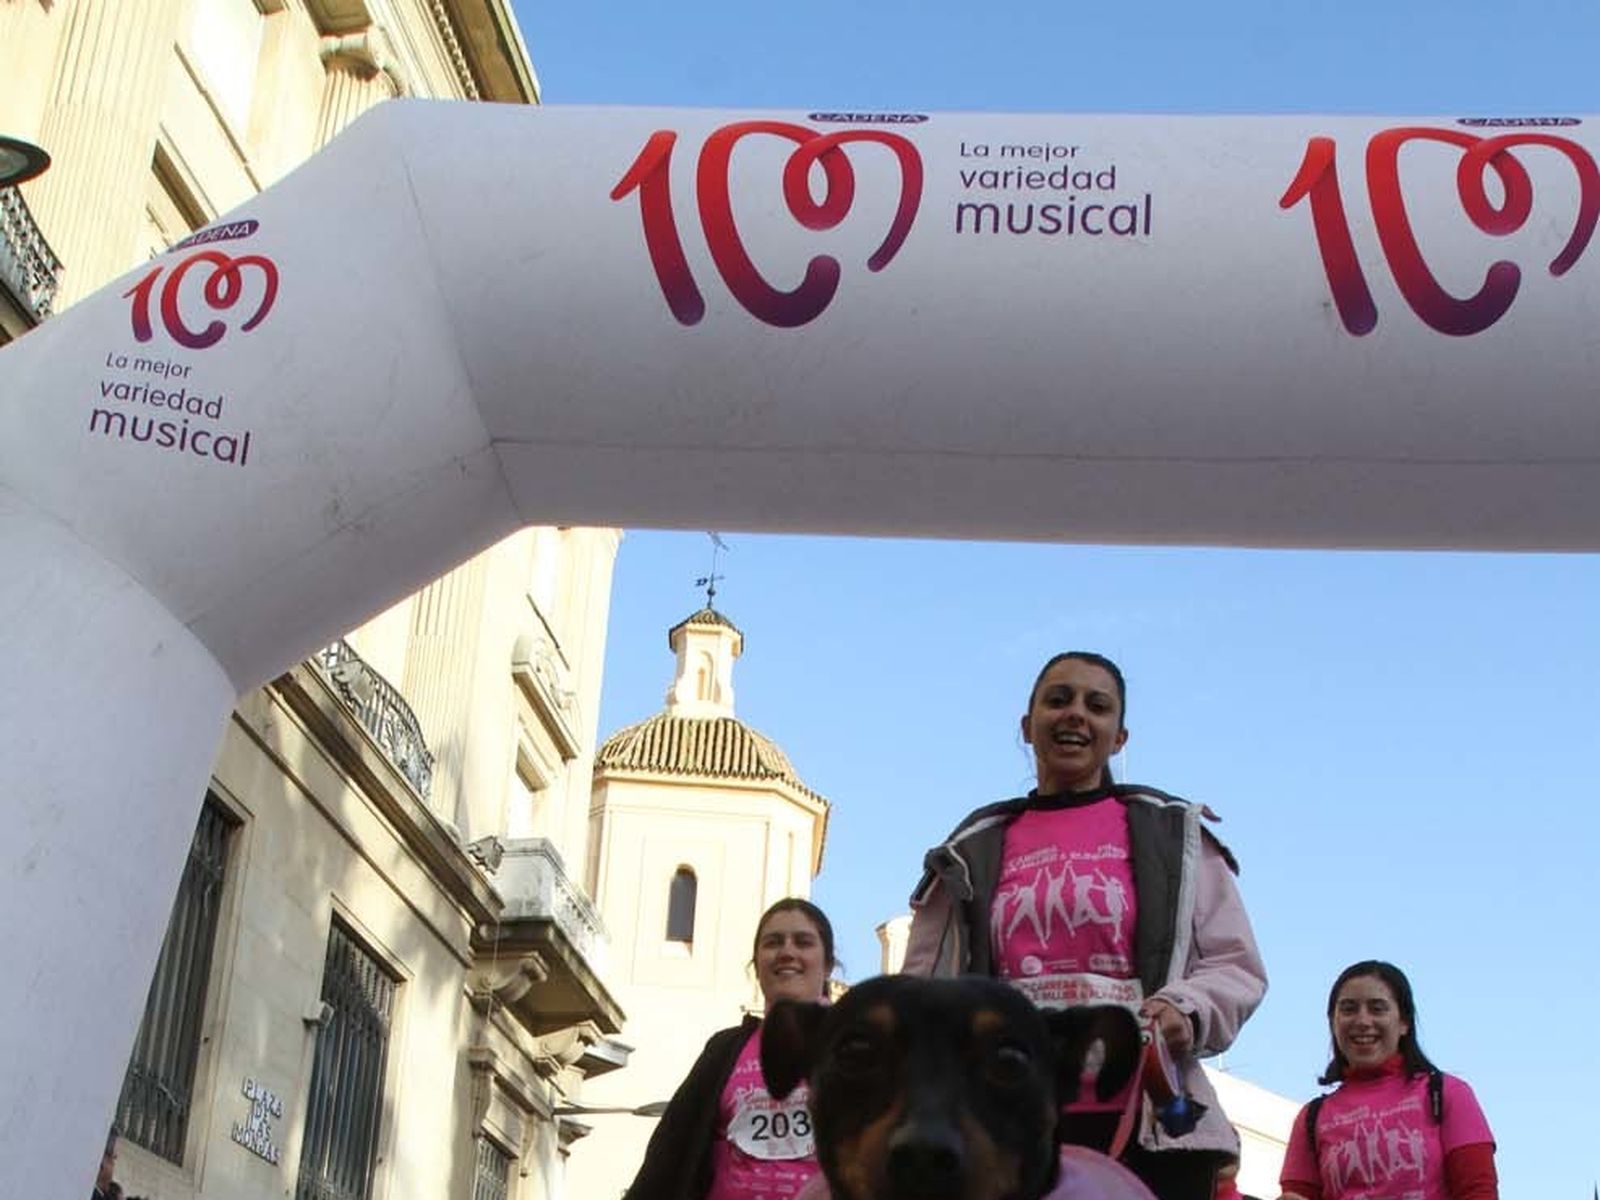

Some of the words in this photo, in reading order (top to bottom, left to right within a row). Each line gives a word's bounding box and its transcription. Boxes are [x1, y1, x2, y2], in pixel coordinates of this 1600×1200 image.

[813, 113, 925, 123] CADENA
[959, 142, 990, 159] La
[1000, 142, 1080, 162] mejor
[959, 166, 1116, 190] variedad
[955, 194, 1153, 236] musical
[105, 352, 129, 371] La
[133, 357, 192, 380] mejor
[100, 380, 224, 420] variedad
[89, 407, 252, 467] musical
[751, 1110, 811, 1141] 203
